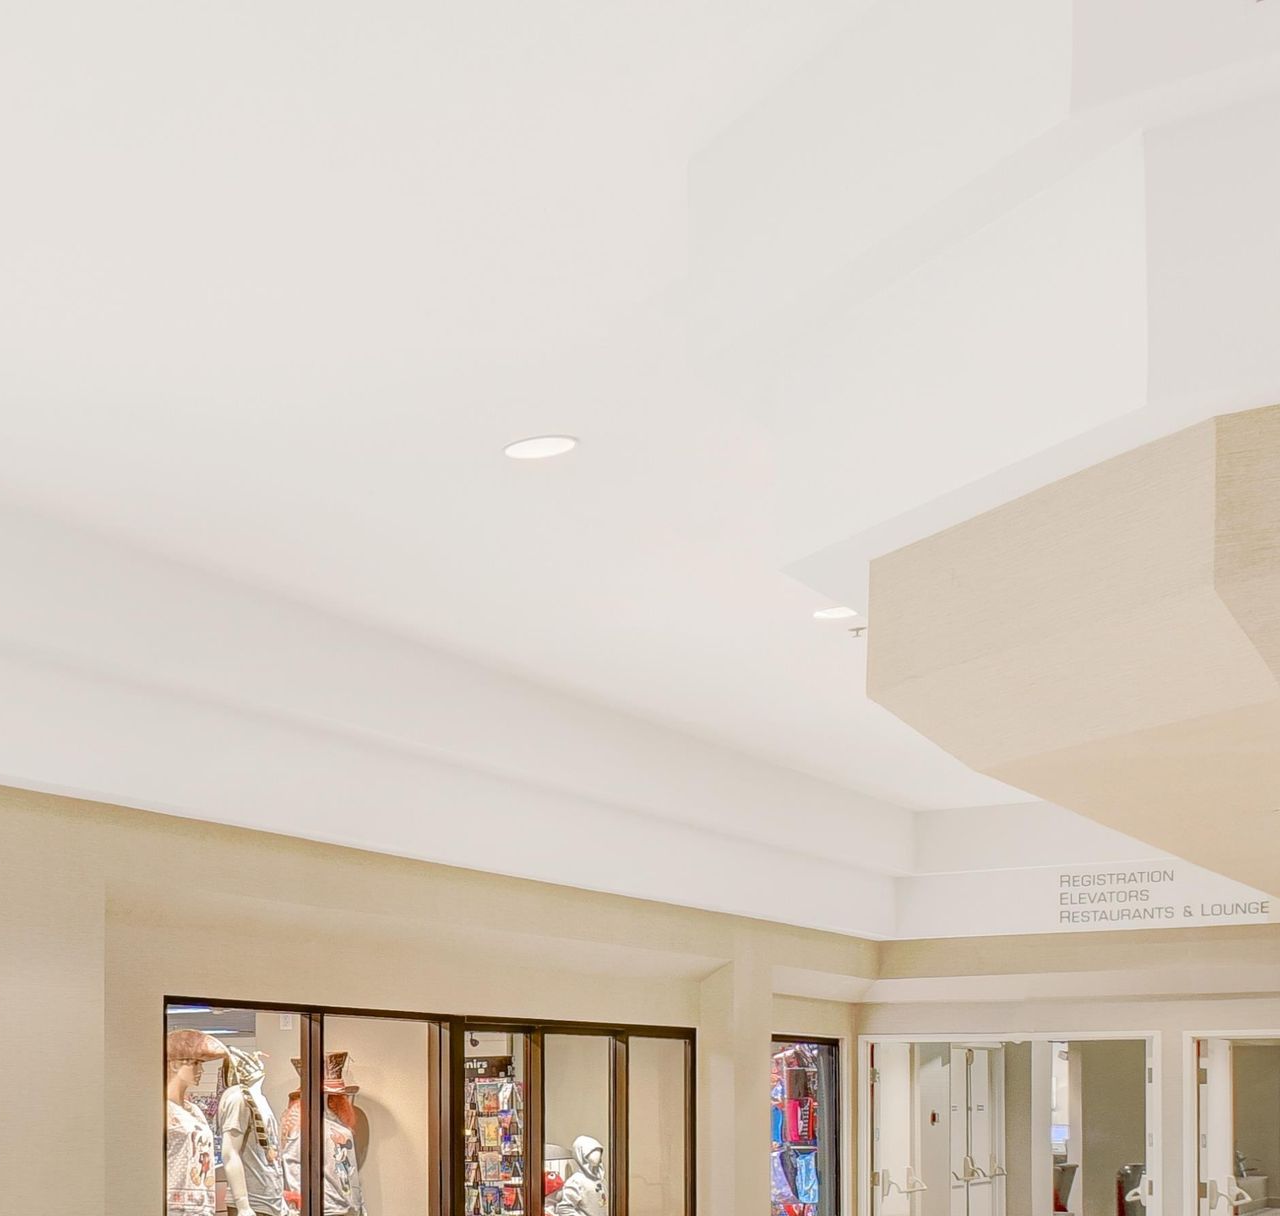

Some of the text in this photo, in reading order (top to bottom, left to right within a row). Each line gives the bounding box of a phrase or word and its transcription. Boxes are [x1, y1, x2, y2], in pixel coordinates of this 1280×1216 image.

[1059, 870, 1175, 888] REGISTRATION
[1059, 889, 1150, 906] ELEVATORS
[1059, 901, 1270, 924] RESTAURANTS & LOUNGE
